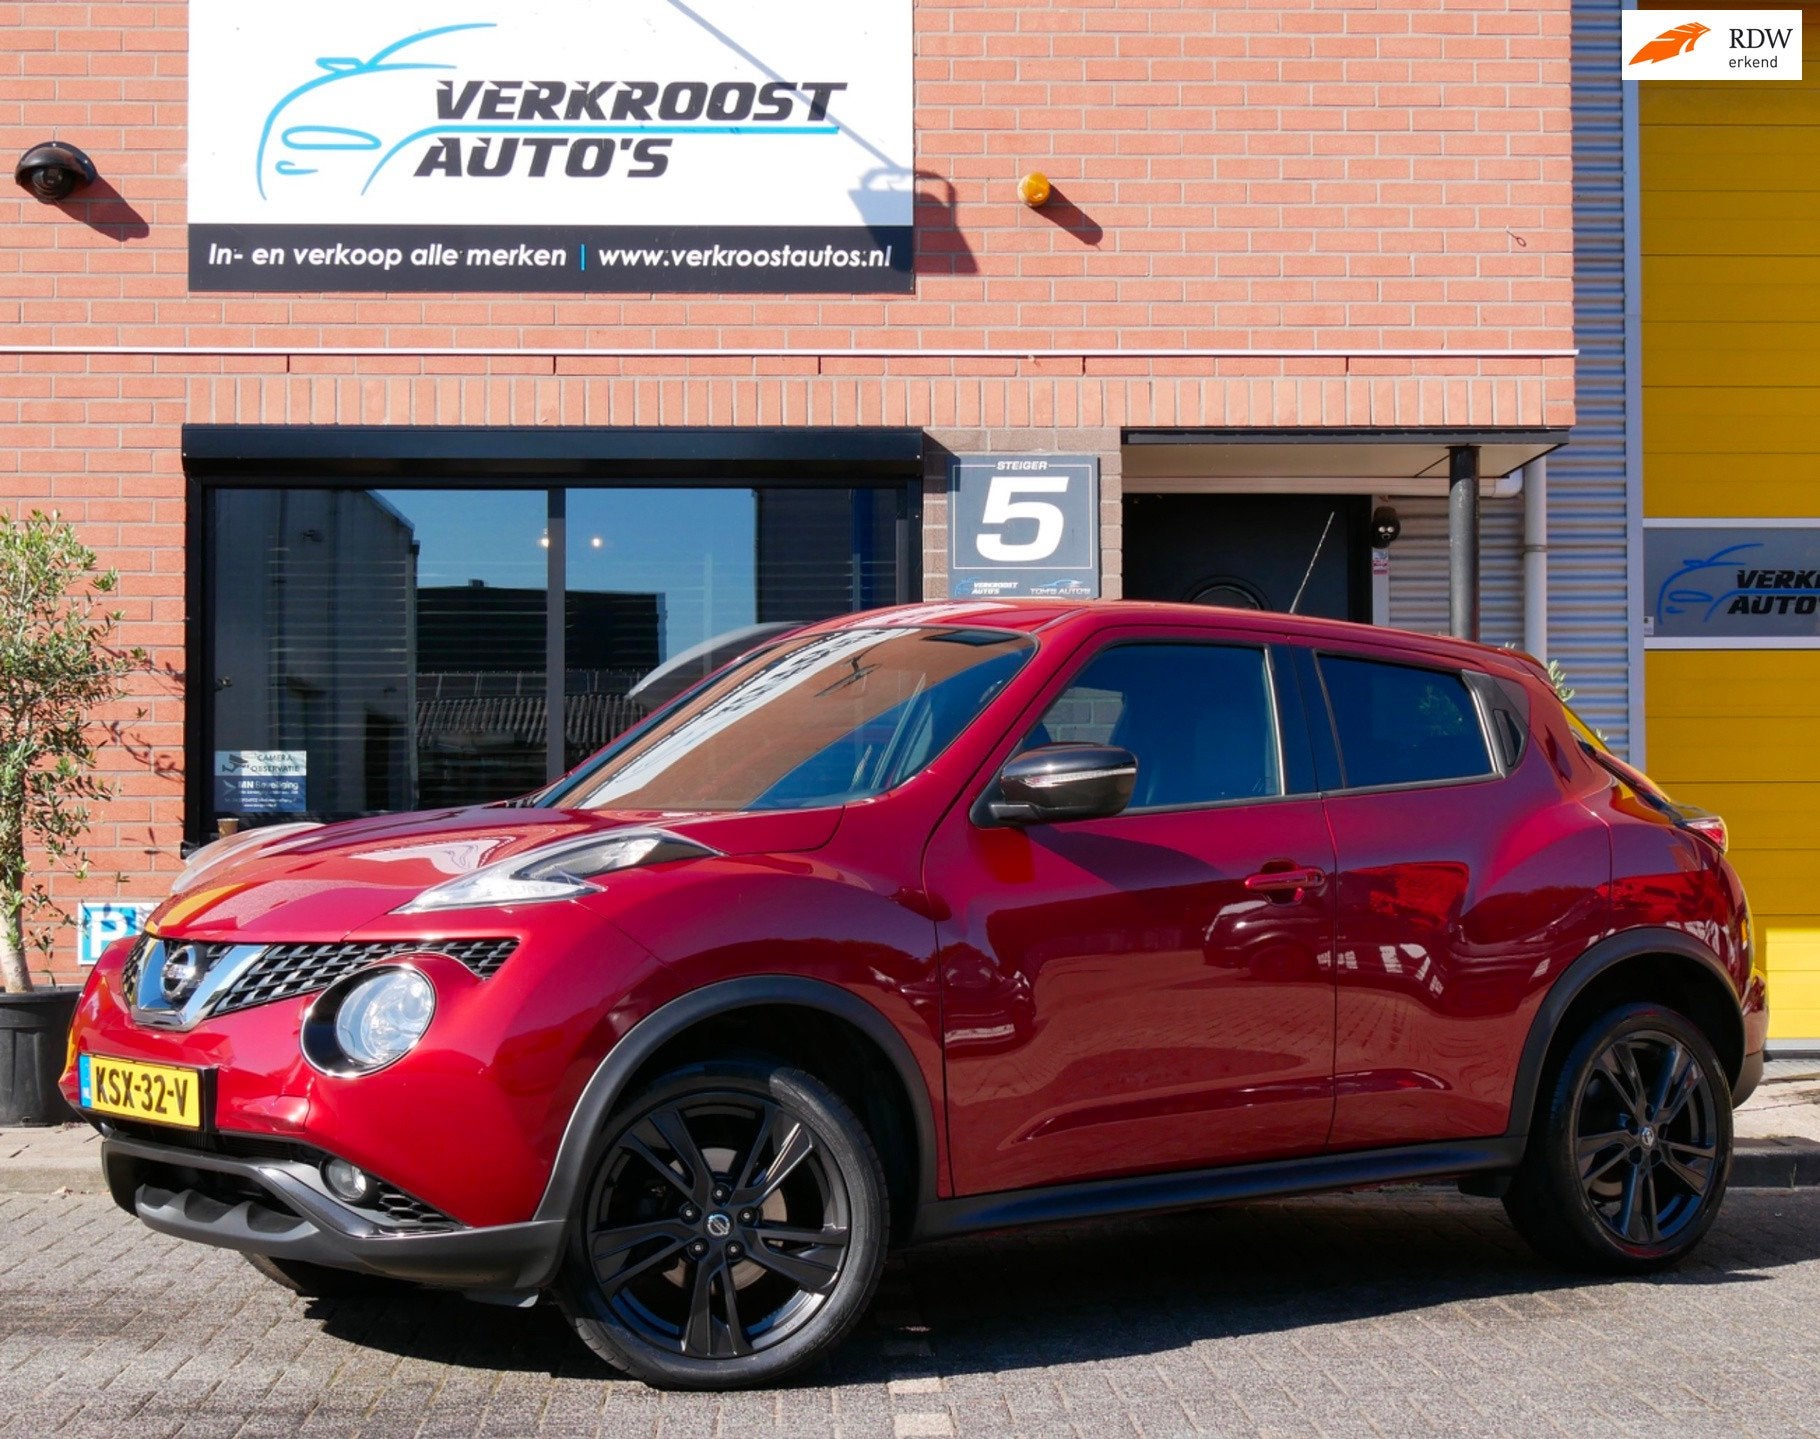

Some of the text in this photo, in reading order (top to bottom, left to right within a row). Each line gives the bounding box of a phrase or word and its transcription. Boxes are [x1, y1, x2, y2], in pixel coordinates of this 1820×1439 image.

[436, 80, 848, 121] VERKROOST
[413, 137, 673, 178] AUTO'S
[208, 243, 892, 270] In- en verkoop alle merken www.verkroostautos.nl
[996, 460, 1048, 471] STEIGER
[976, 476, 1070, 562] 5
[1737, 569, 1820, 588] VERK
[1727, 596, 1820, 615] AUTO
[96, 1066, 188, 1117] KSX-32-V
